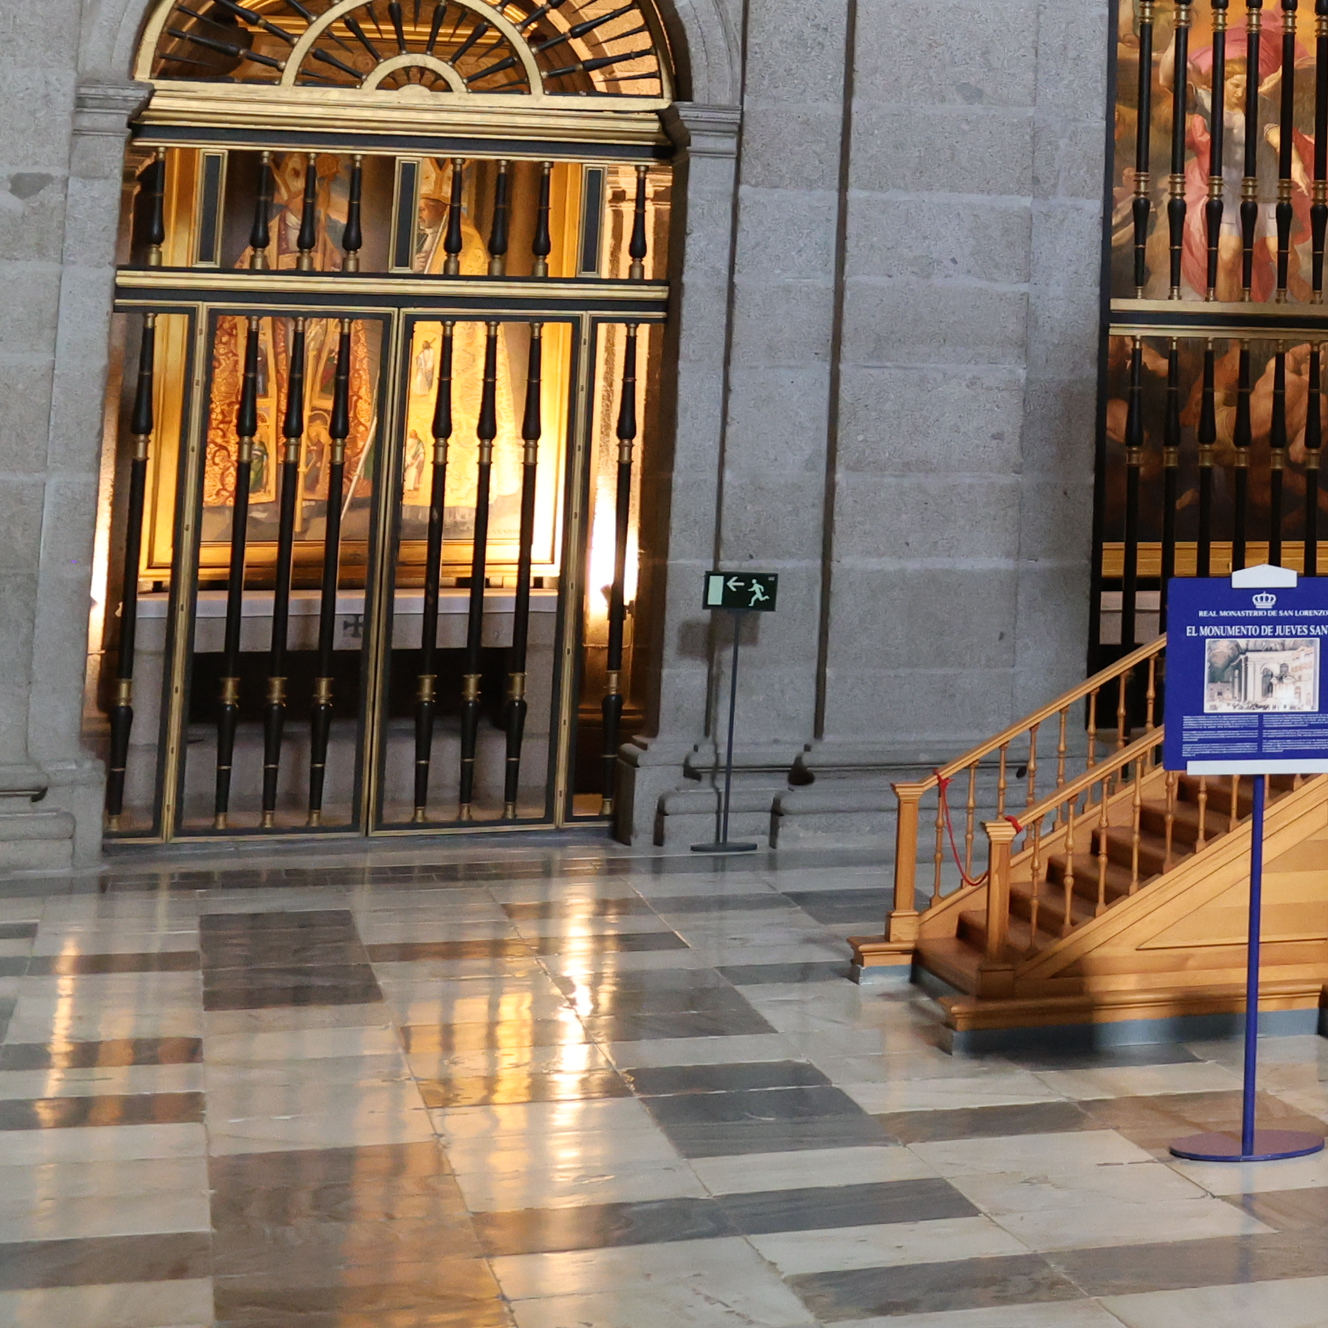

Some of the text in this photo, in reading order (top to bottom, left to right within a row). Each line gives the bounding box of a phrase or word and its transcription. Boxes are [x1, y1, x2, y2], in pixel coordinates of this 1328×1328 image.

[1187, 626, 1198, 636] EL
[1199, 625, 1259, 636] MONUMENTO
[1261, 625, 1273, 635] DE
[1274, 625, 1308, 635] JUEVES
